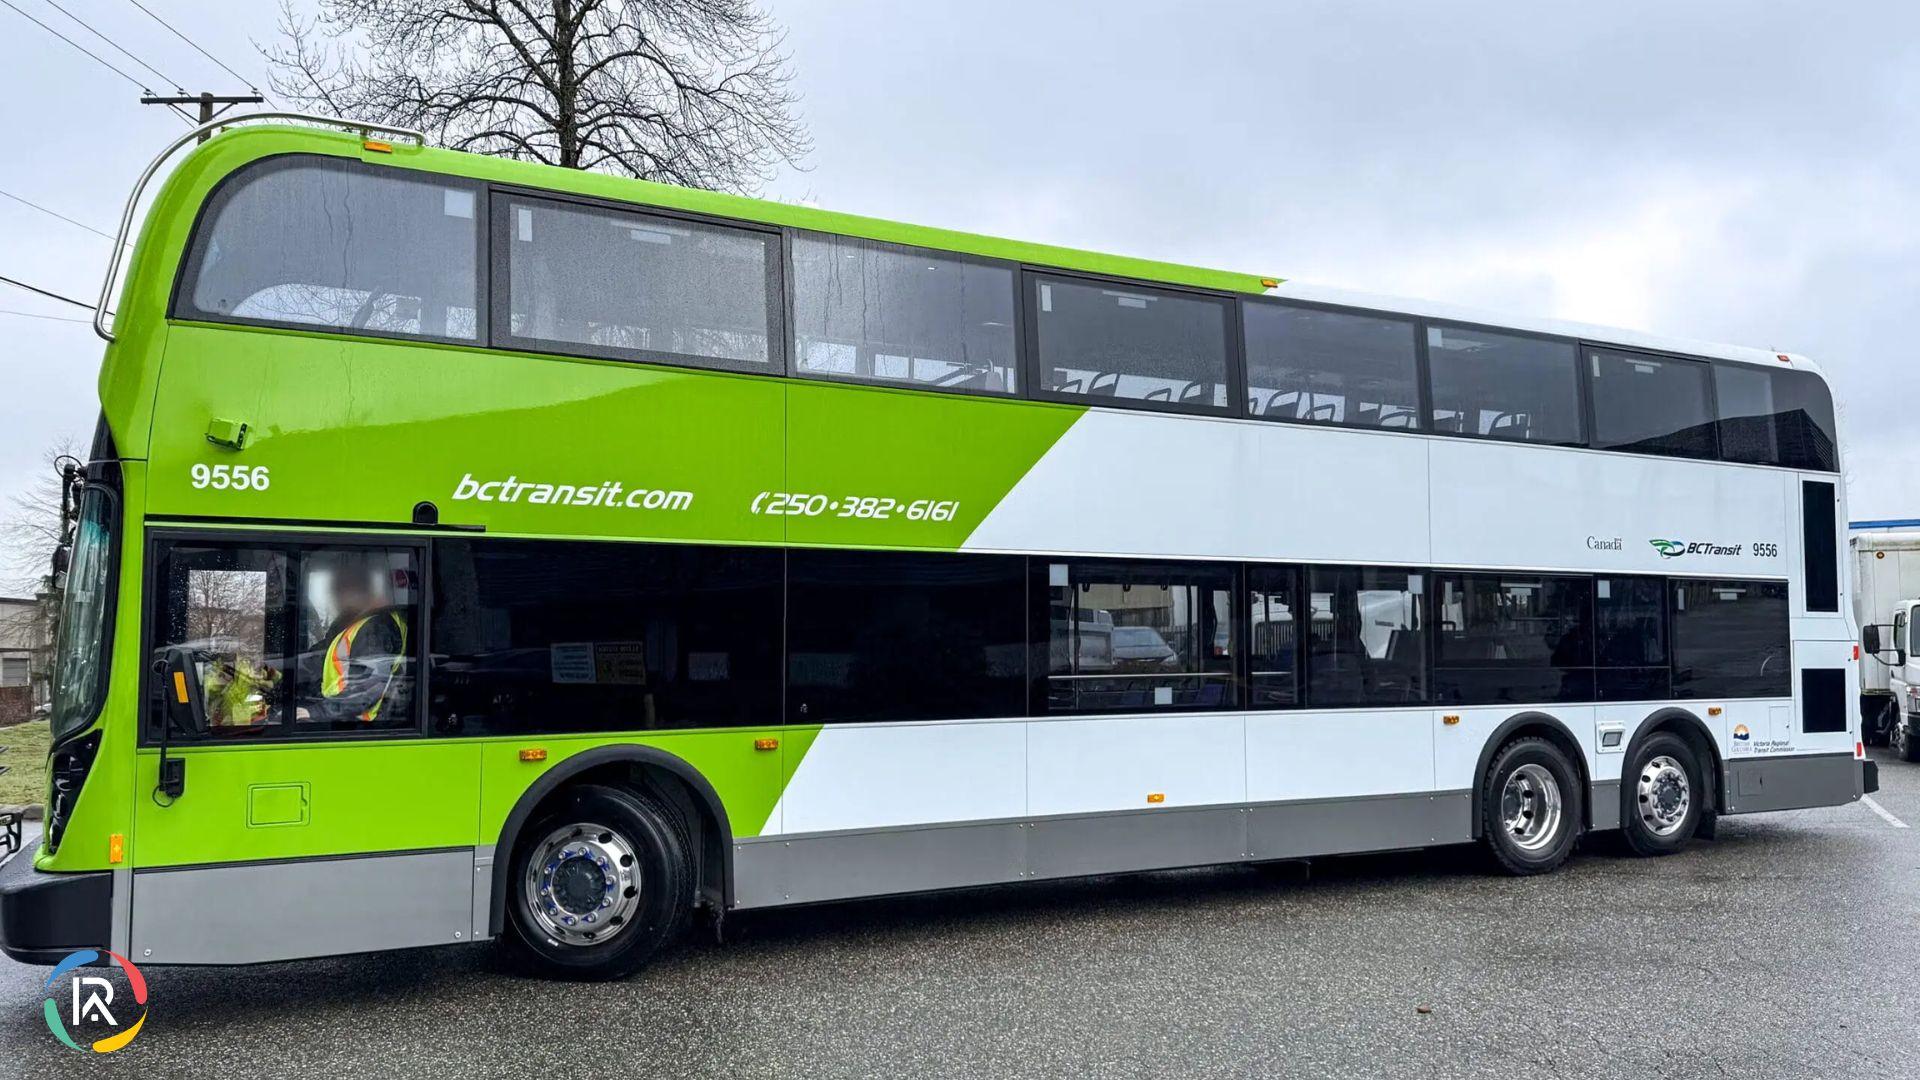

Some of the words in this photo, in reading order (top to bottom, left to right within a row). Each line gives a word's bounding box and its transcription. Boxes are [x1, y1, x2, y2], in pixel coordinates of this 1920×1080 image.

[191, 463, 270, 491] 9556
[452, 473, 694, 512] bctransit.com
[1586, 535, 1623, 551] Canada
[1686, 542, 1742, 556] BCTransit
[1752, 542, 1778, 558] 9556
